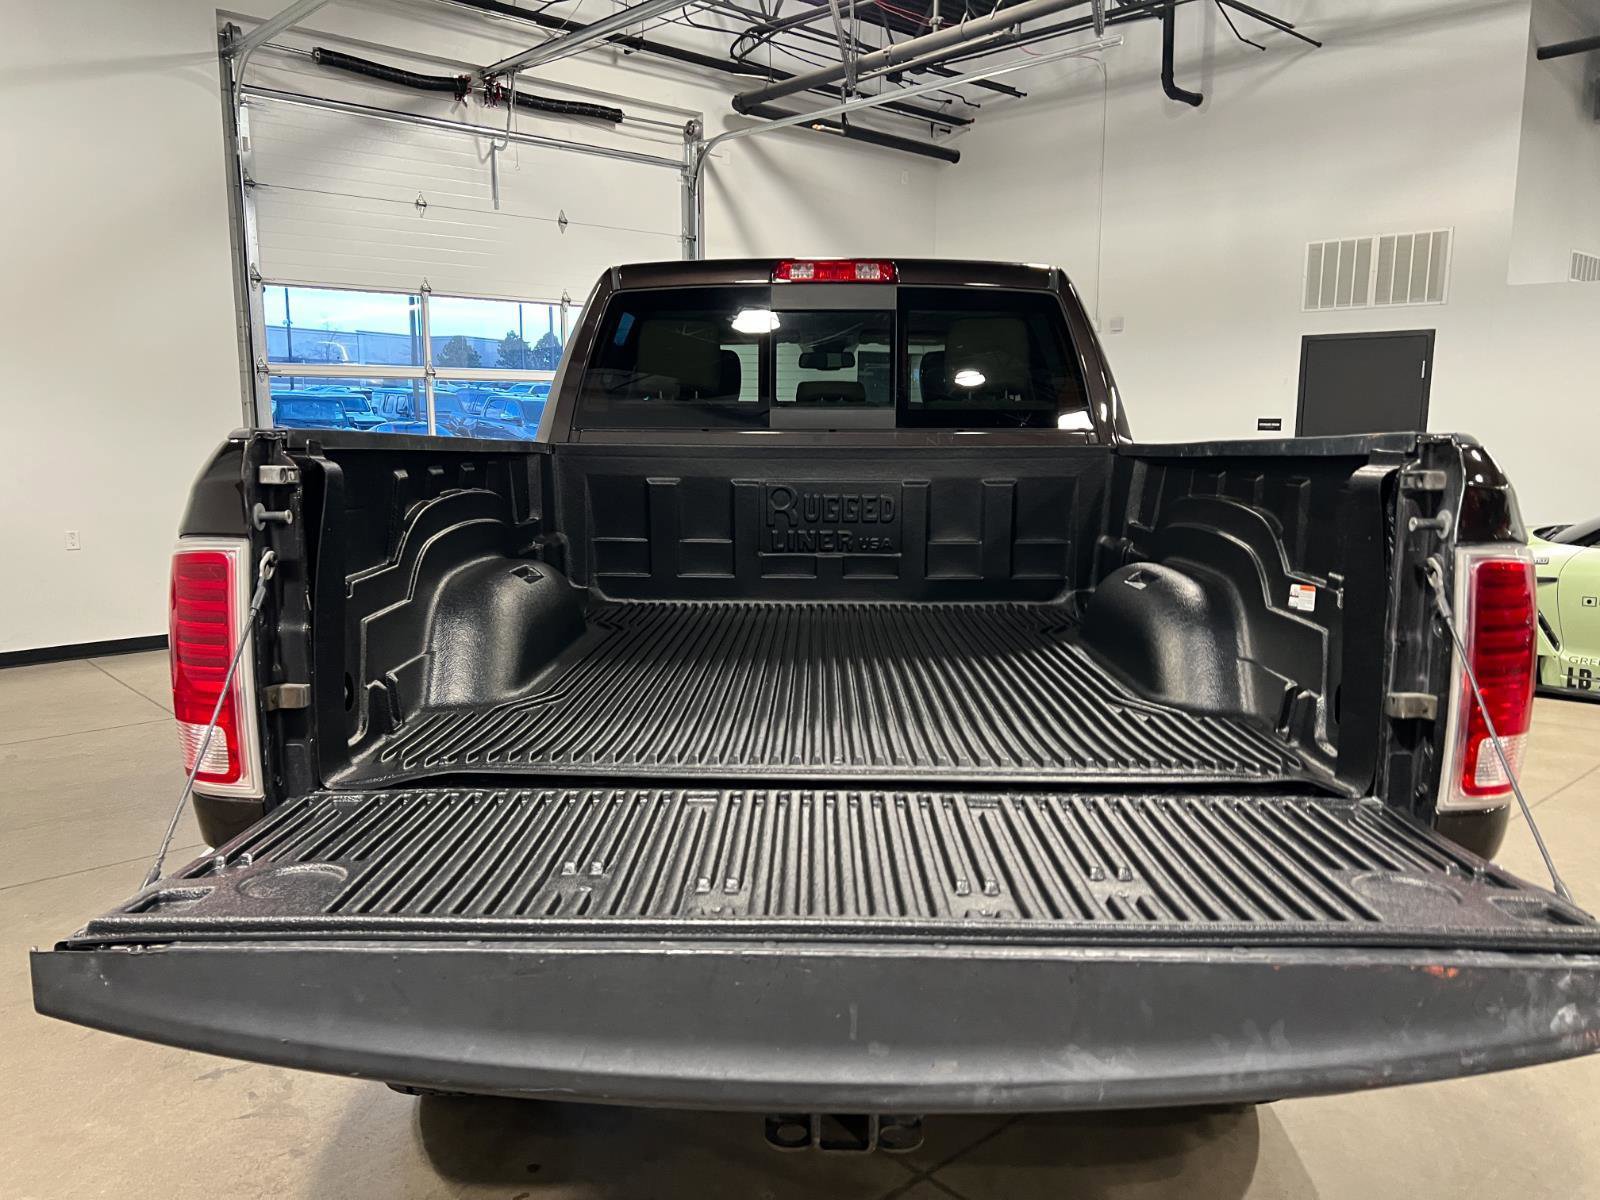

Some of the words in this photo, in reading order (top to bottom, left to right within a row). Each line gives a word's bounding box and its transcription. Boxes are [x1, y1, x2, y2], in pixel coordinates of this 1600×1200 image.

[766, 484, 896, 527] RUGGED
[771, 530, 853, 551] LINER
[858, 537, 893, 551] USA
[1569, 656, 1600, 666] GRE
